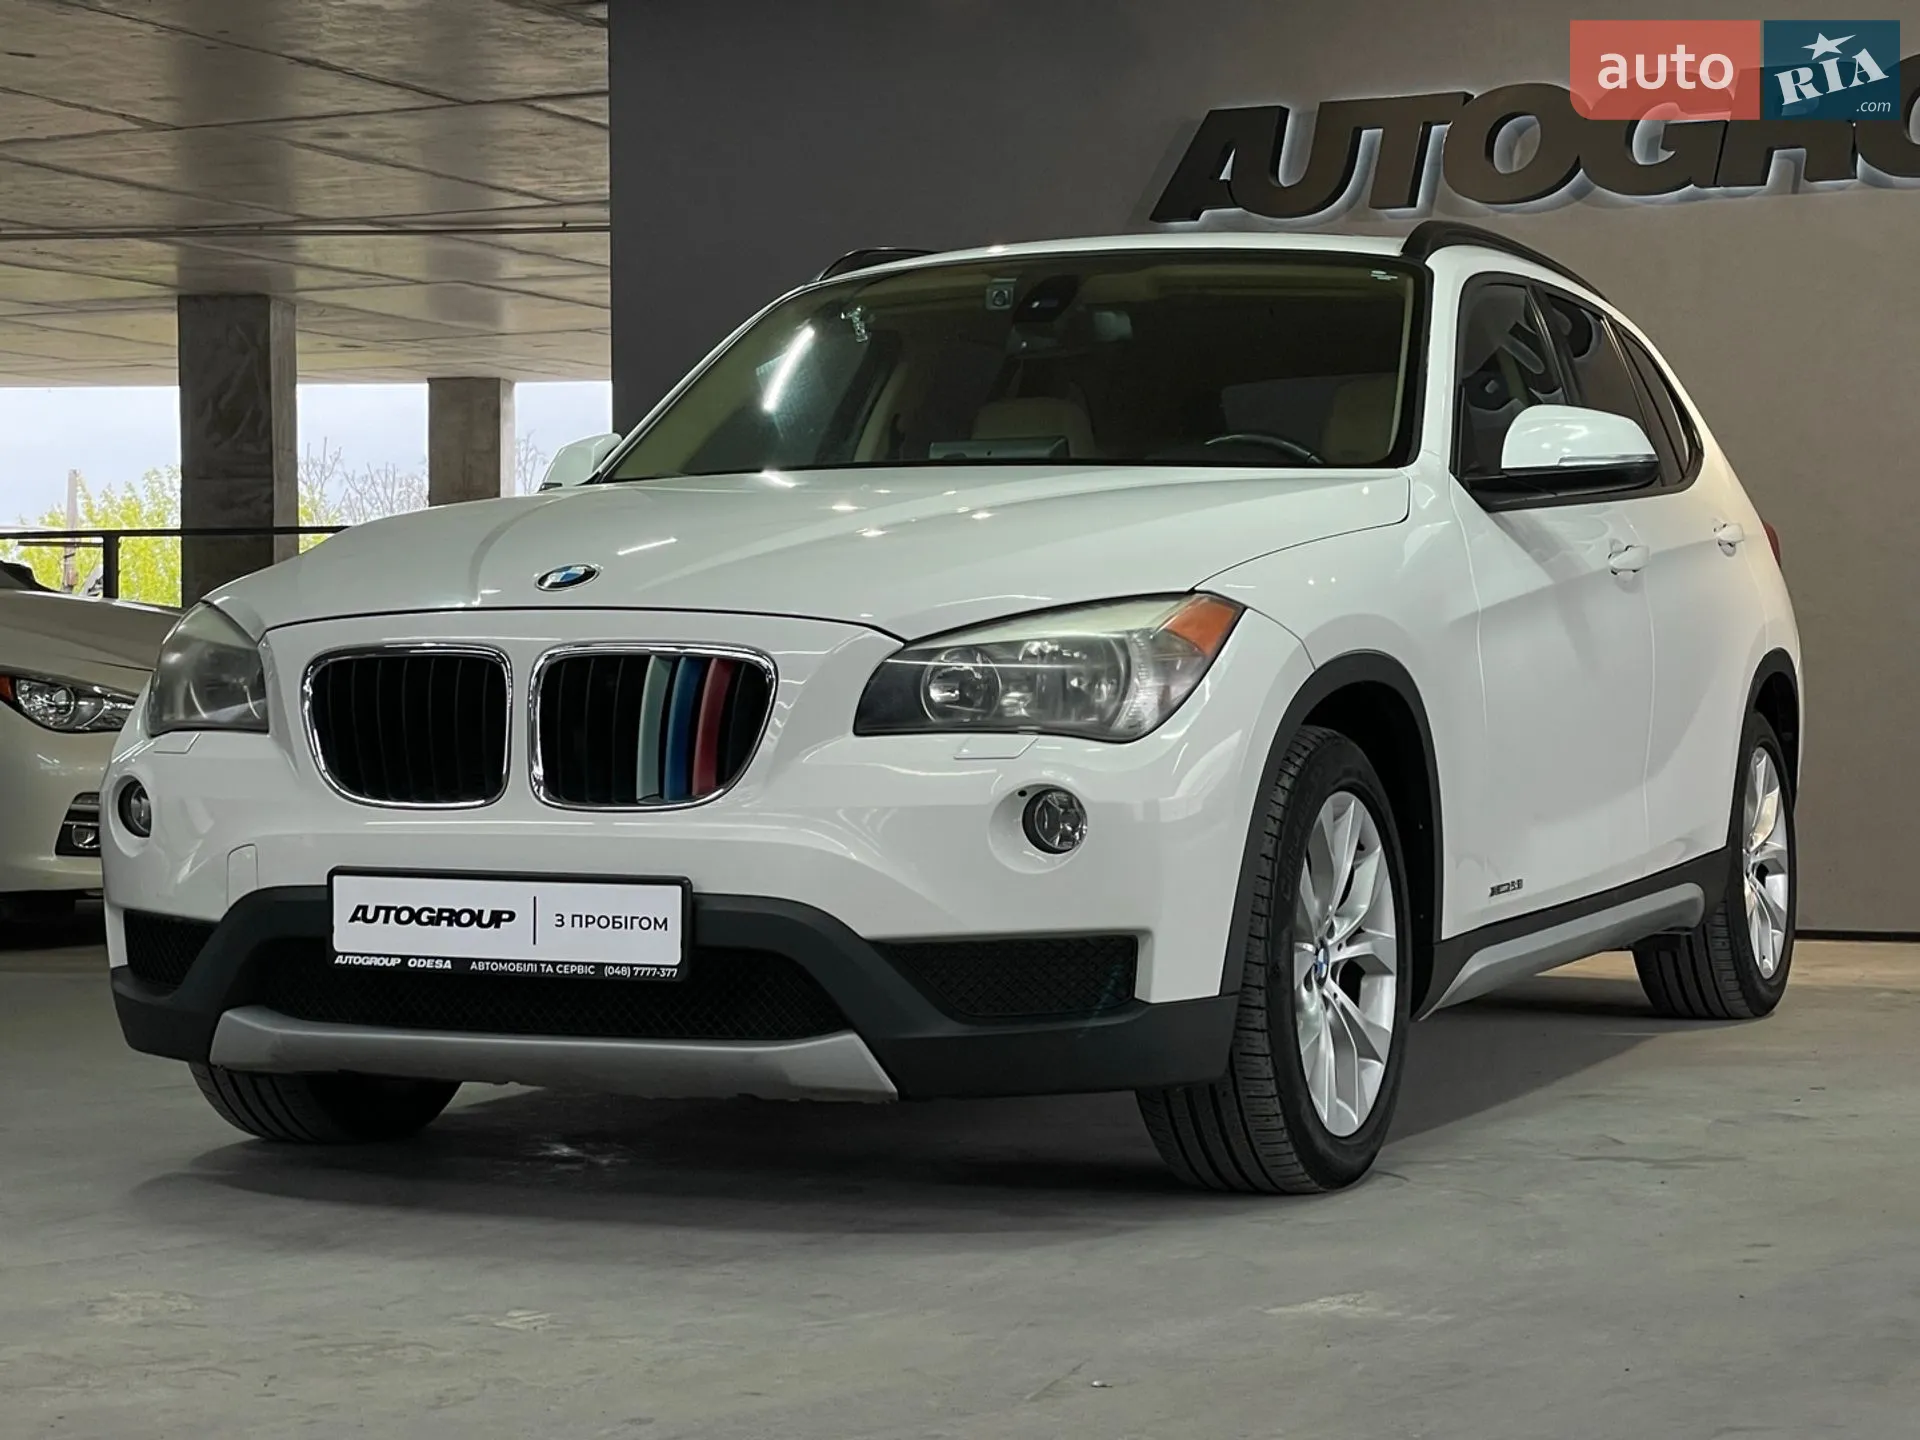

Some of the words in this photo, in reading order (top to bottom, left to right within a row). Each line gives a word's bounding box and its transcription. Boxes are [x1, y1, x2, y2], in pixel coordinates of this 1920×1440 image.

[348, 904, 516, 930] AUTOGROUP
[570, 914, 668, 931] ПРОБІГОМ
[334, 955, 402, 967] AUTOGROUP
[407, 957, 452, 969] ODESA
[470, 961, 537, 973] АВТОМОБІЛІ
[539, 963, 554, 974] ТА
[556, 963, 595, 975] СЕРВІС
[604, 965, 631, 978] (048)
[633, 967, 677, 978] 7777-377
